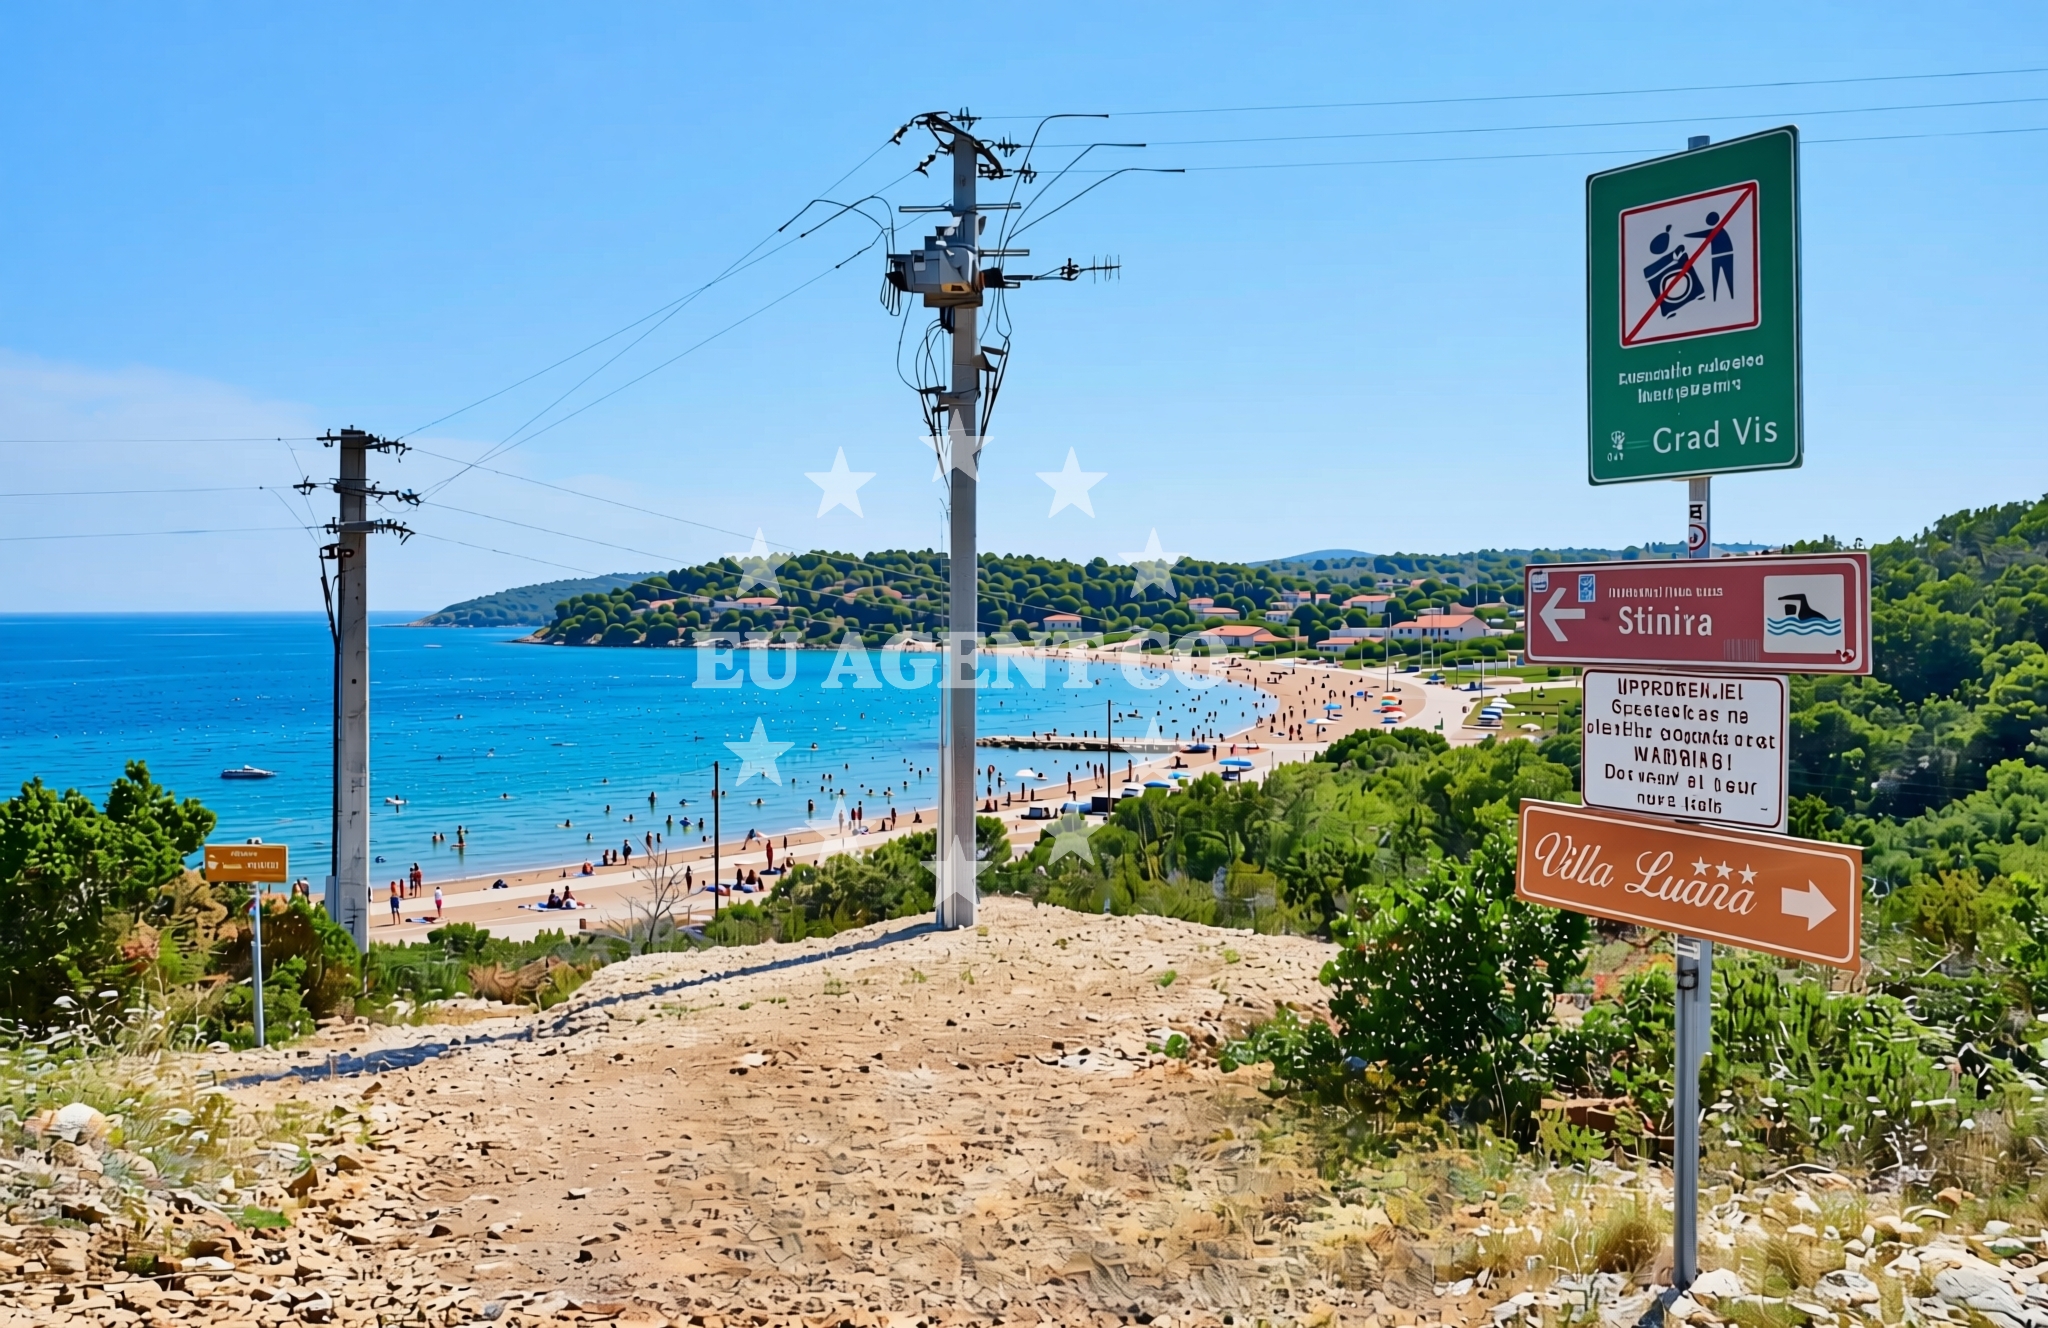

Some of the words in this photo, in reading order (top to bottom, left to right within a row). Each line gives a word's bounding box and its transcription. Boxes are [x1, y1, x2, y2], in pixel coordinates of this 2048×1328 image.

[1653, 420, 1720, 453] Crad
[1732, 416, 1778, 445] Vis
[1534, 832, 1614, 888] Villa
